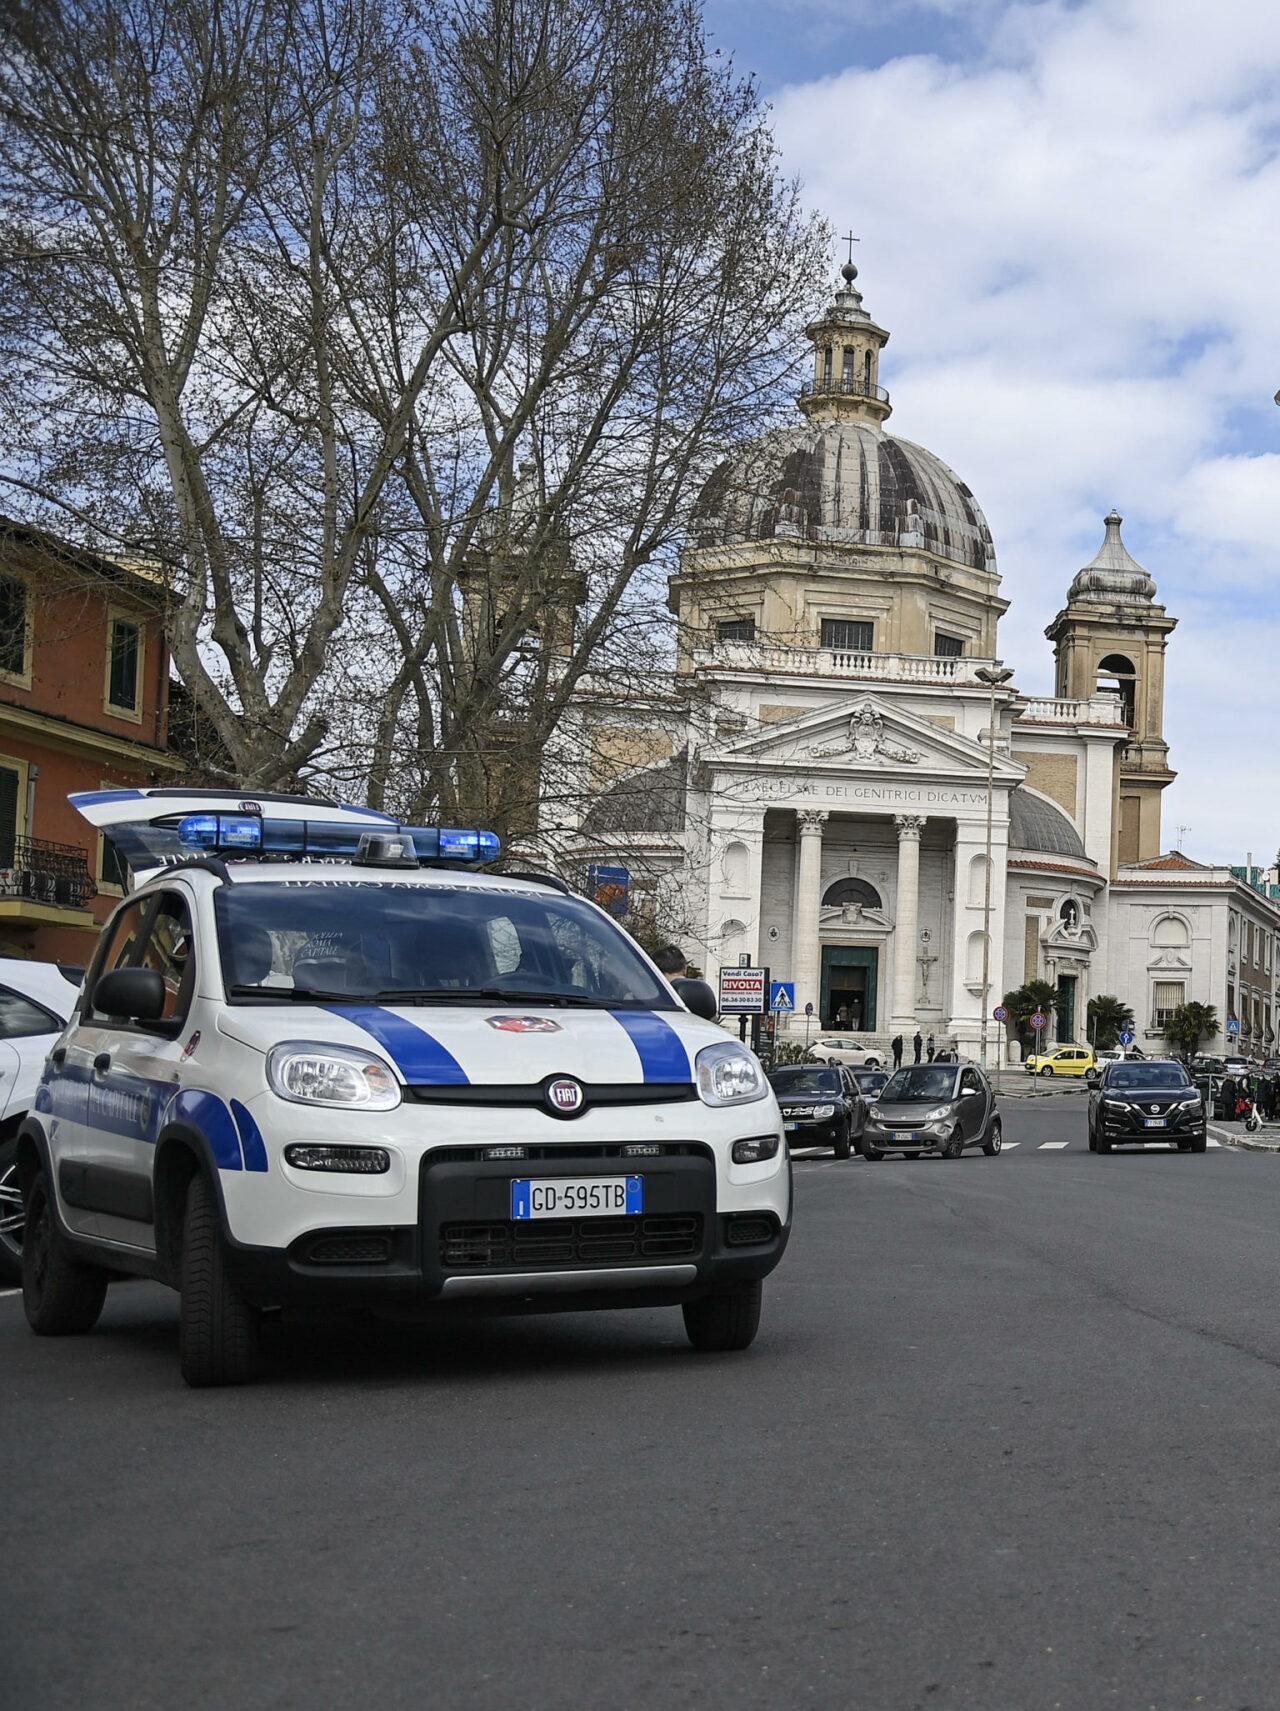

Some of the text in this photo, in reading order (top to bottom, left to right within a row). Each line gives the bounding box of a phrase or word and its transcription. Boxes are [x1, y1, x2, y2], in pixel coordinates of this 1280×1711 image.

[825, 786, 848, 797] DEI
[854, 787, 921, 801] GENITRICI
[927, 791, 988, 805] DICATVM
[723, 980, 761, 989] RIVOLTA
[556, 1087, 576, 1102] FIAT
